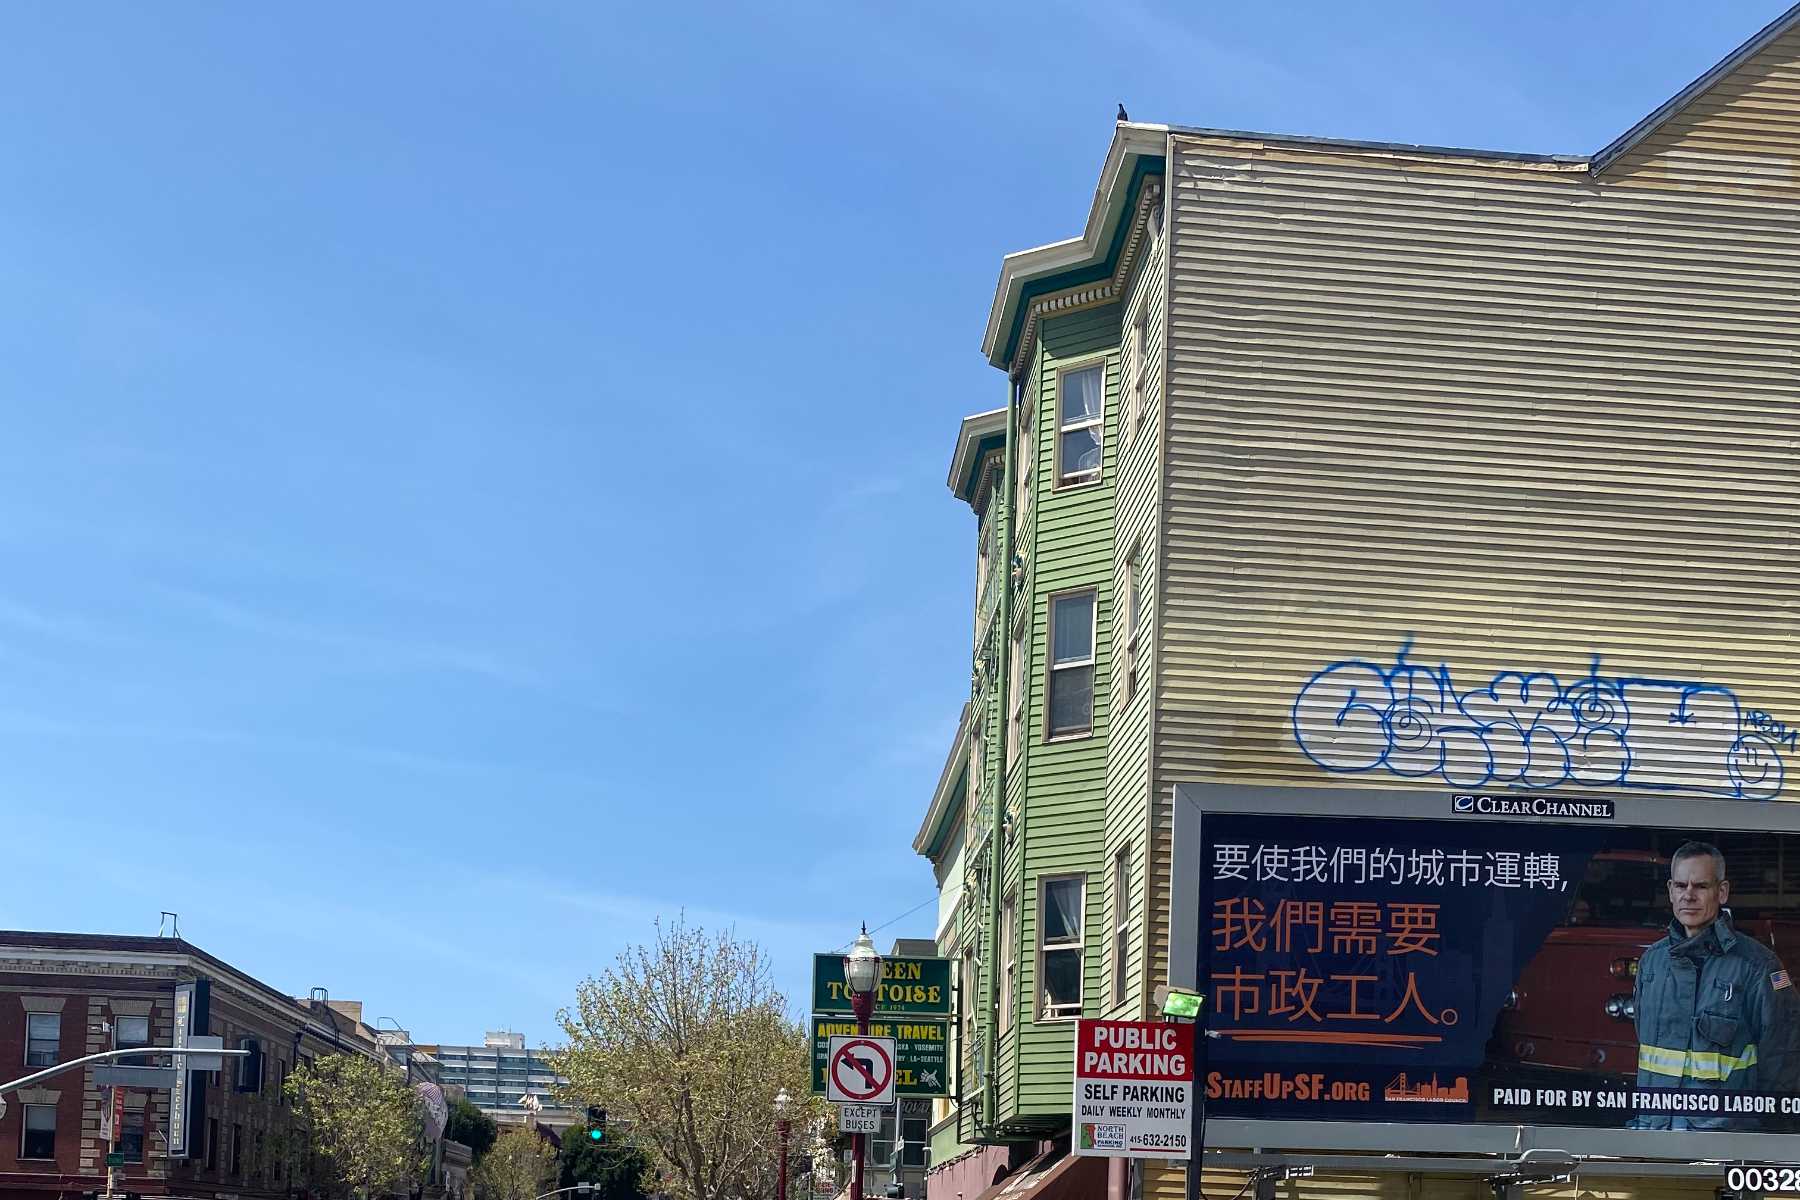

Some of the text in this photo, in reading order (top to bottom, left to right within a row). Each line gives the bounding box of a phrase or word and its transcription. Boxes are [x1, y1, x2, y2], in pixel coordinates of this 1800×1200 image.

[1211, 897, 1442, 956] 我們需要
[827, 981, 941, 1003] TOTOISE
[1210, 965, 1459, 1027] 市政工人。
[818, 1023, 944, 1040] ADVENURE TRAVEL
[1094, 1026, 1177, 1051] PUBLIC
[1084, 1051, 1186, 1076] PARKING
[1084, 1083, 1185, 1103] SELF PARKING
[1493, 1088, 1531, 1106] PAID
[1536, 1089, 1567, 1107] FOR
[1572, 1090, 1591, 1108] BY
[1597, 1091, 1627, 1109] SAN
[1631, 1092, 1719, 1112] FRANCISCO
[1724, 1095, 1776, 1114] LABOR
[844, 1107, 877, 1118] EXCEPT
[1081, 1105, 1186, 1120] DAILY WEEKLY MONTHLY
[845, 1120, 875, 1130] BUSES
[1130, 1133, 1187, 1147] 415-632-2150
